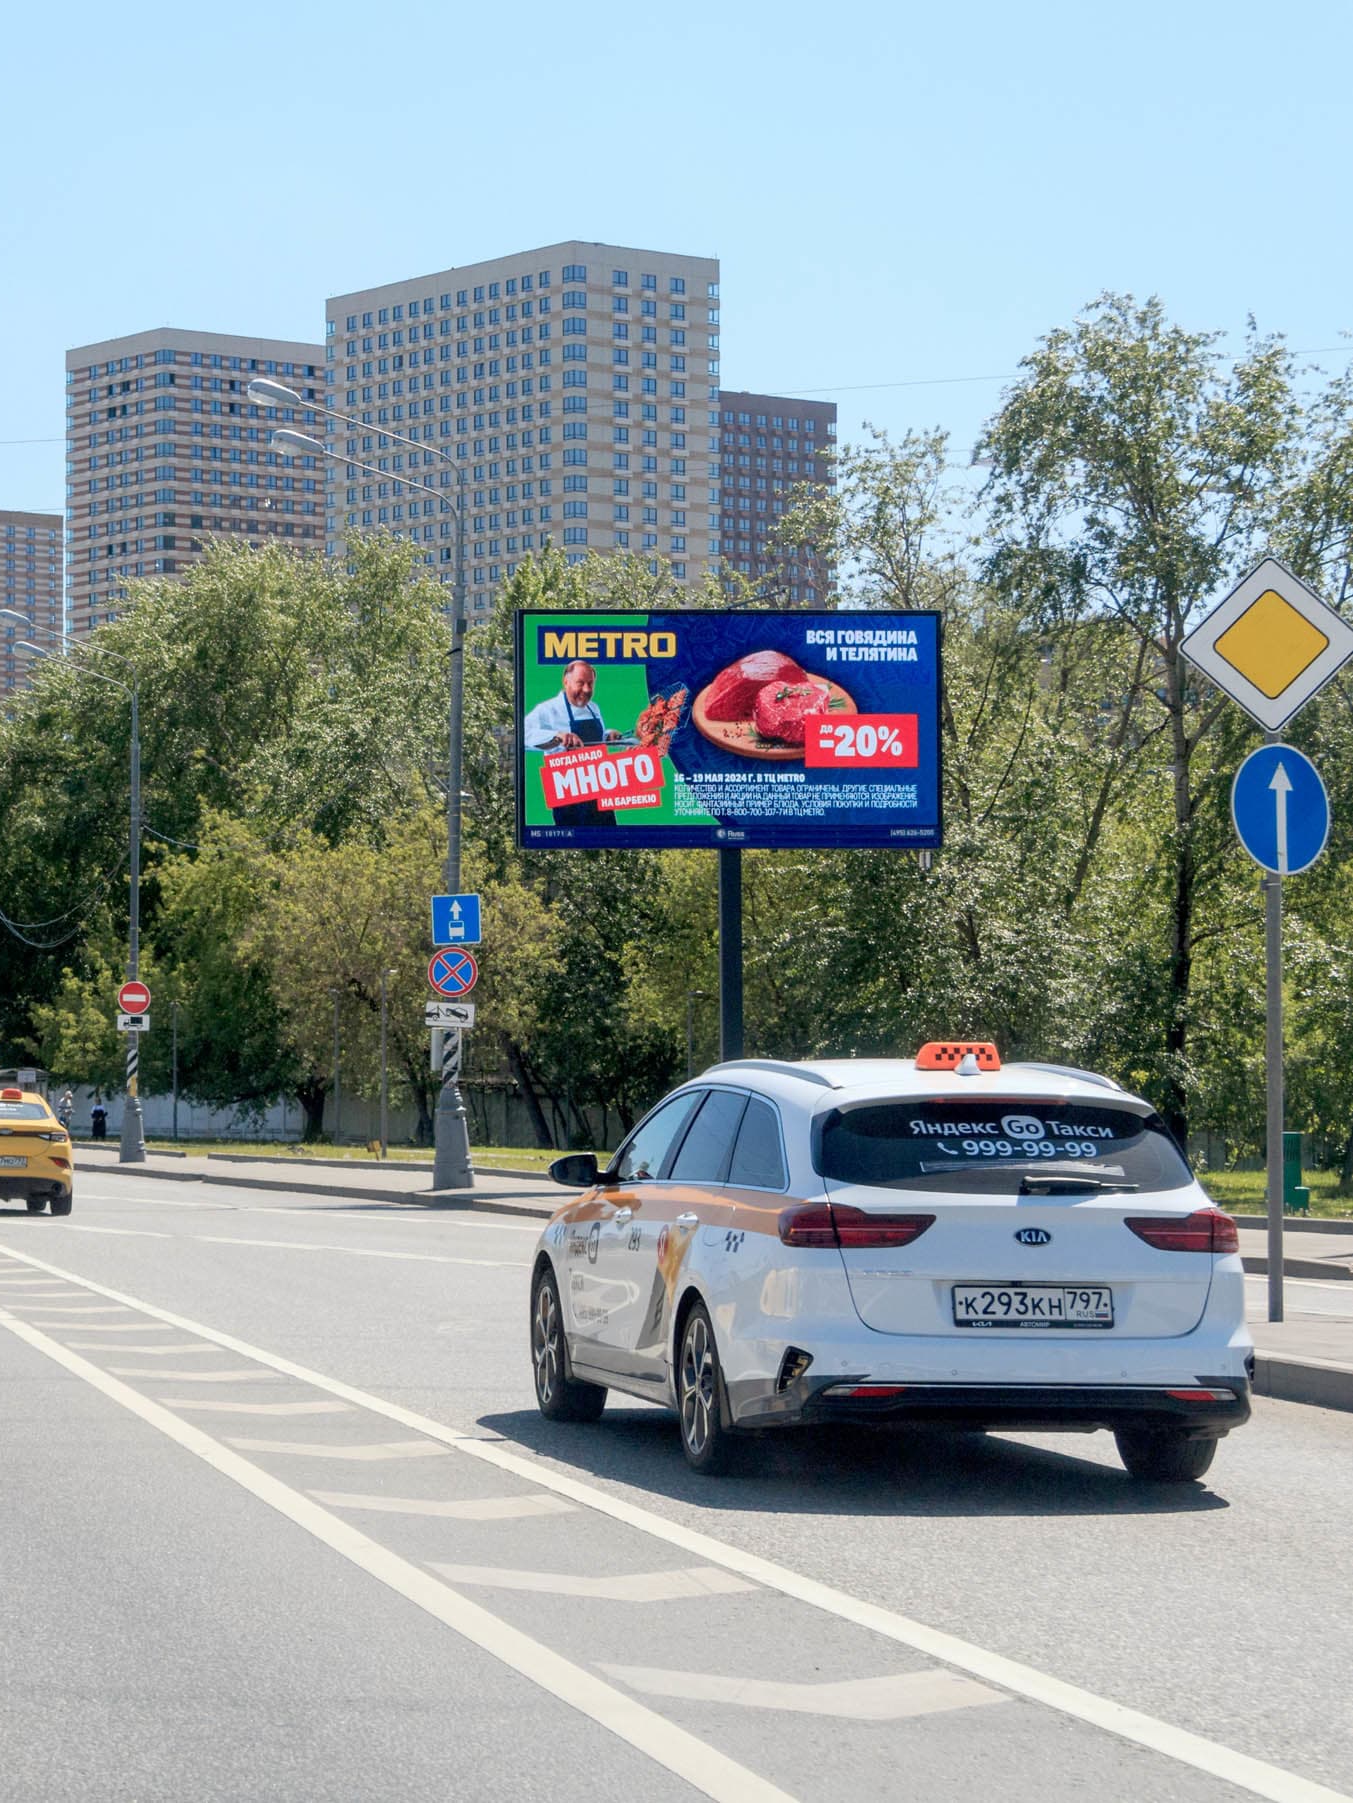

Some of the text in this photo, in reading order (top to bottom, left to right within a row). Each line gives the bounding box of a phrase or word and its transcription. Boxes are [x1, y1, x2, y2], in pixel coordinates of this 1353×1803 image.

[544, 632, 677, 658] METRO
[806, 630, 918, 646] ВСЯ ГОВЯДИНА
[826, 647, 918, 661] И ТЕЛЯТИНА
[819, 725, 903, 757] -20%
[549, 750, 603, 768] КОГДА НАДО
[552, 754, 655, 800] МНОГО
[673, 774, 684, 782] 16
[693, 774, 704, 782] 19
[704, 774, 724, 782] МАЯ
[724, 774, 747, 782] 2024
[757, 774, 763, 782] В
[764, 774, 777, 783] ТЦ
[777, 774, 806, 782] METRO
[718, 784, 723, 792] И
[725, 784, 770, 792] АССОРТИМЕНТ
[770, 784, 795, 792] ТОВАРА
[869, 784, 917, 792] СПЕЦИАЛЬНЫЕ
[601, 794, 657, 807] НА БАРБЕКЮ
[909, 1119, 1114, 1138] Яндекс Go Такси
[961, 1140, 1097, 1157] 999-99-99
[1021, 1231, 1048, 1242] KIA
[965, 1291, 1103, 1316] К293КН 797
[1076, 1310, 1095, 1318] RUS
